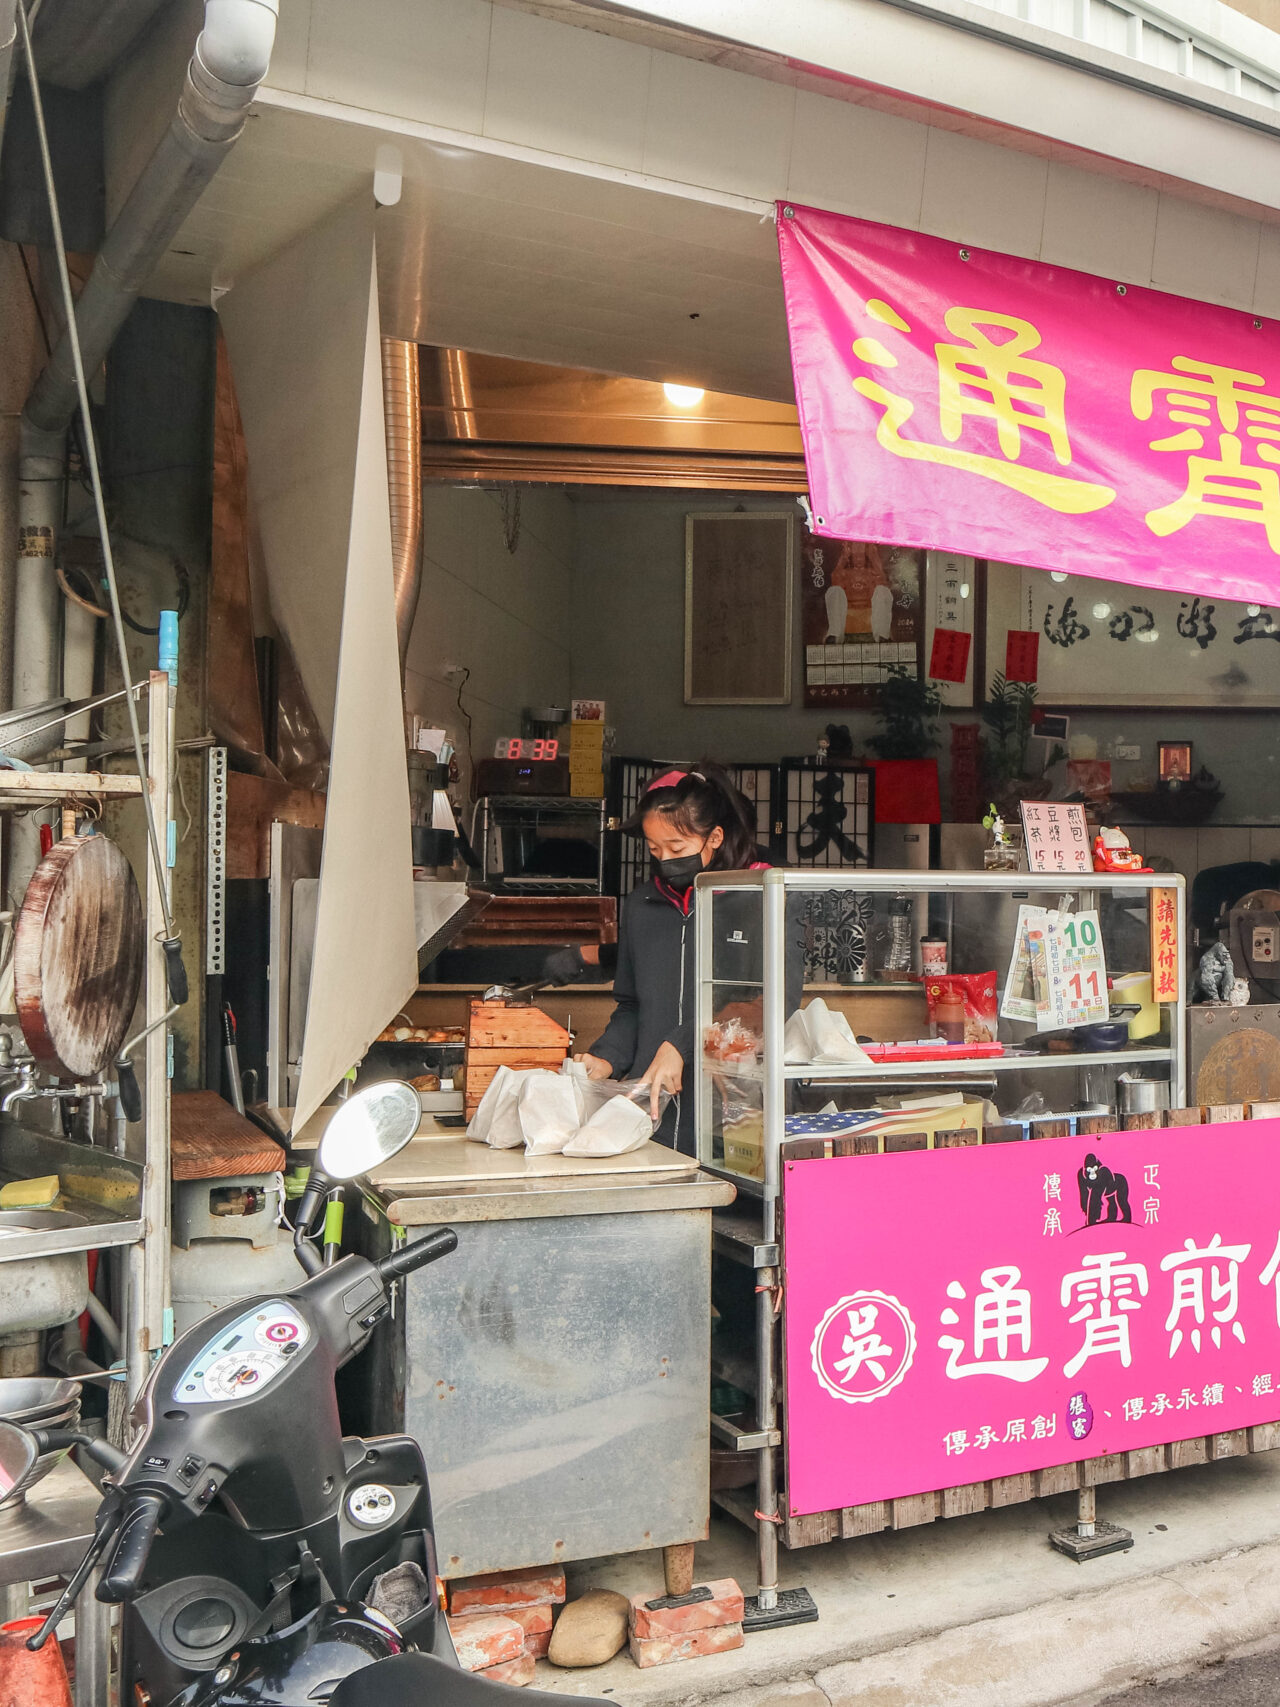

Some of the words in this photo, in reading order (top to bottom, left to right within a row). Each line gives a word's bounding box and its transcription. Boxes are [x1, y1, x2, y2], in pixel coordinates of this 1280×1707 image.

[1026, 806, 1042, 843] 紅茶
[1066, 807, 1083, 843] 煎包
[1064, 920, 1097, 948] 10
[1157, 899, 1177, 995] 請先付款
[1069, 971, 1099, 999] 11
[1043, 1172, 1063, 1237] 傳承
[1143, 1164, 1161, 1225] 正宗
[834, 1304, 893, 1385] 吳
[942, 1413, 1057, 1456] 傳承原創
[1069, 1395, 1088, 1439] 張家
